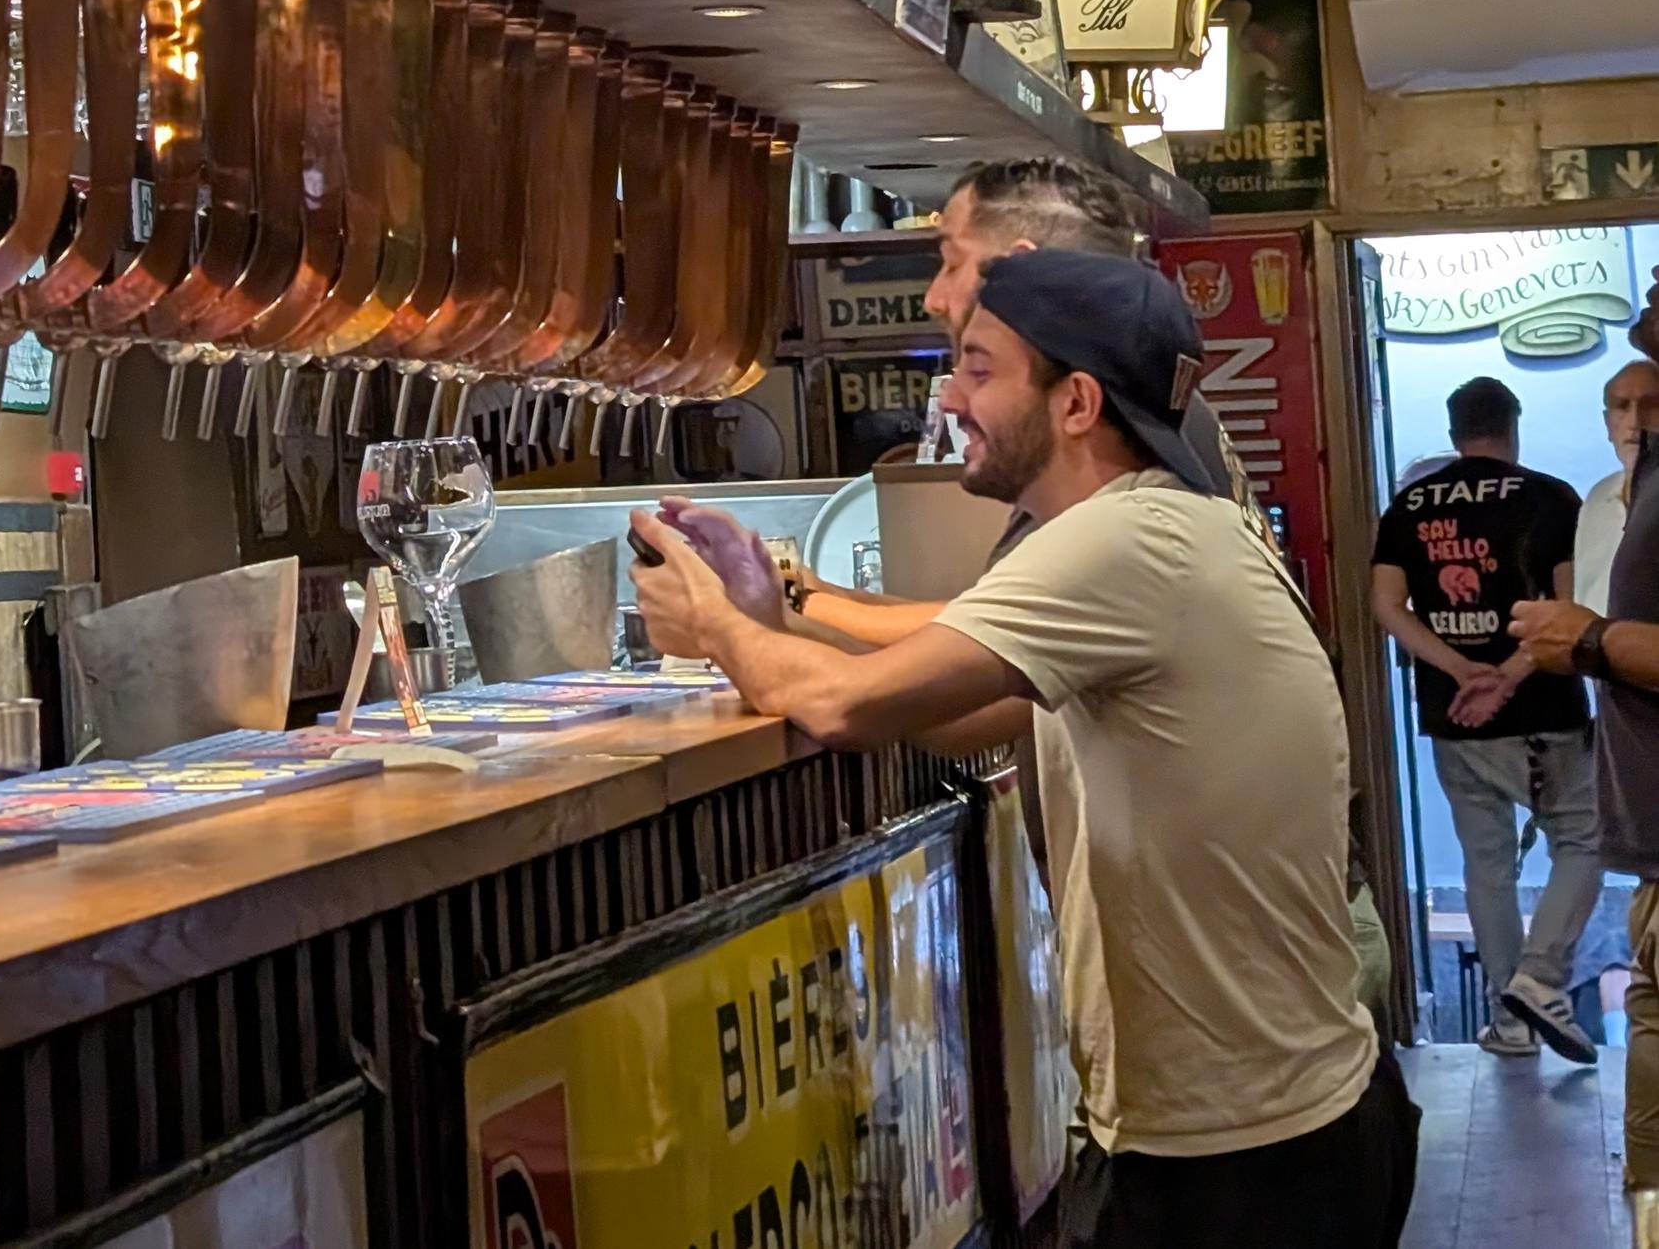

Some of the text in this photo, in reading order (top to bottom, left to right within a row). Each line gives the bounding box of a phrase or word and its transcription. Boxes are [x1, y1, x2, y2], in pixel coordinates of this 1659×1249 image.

[1459, 259, 1609, 319] Genevers
[1405, 476, 1525, 512] STAFF
[1416, 517, 1458, 543] SAY
[1426, 536, 1490, 563] HELLO
